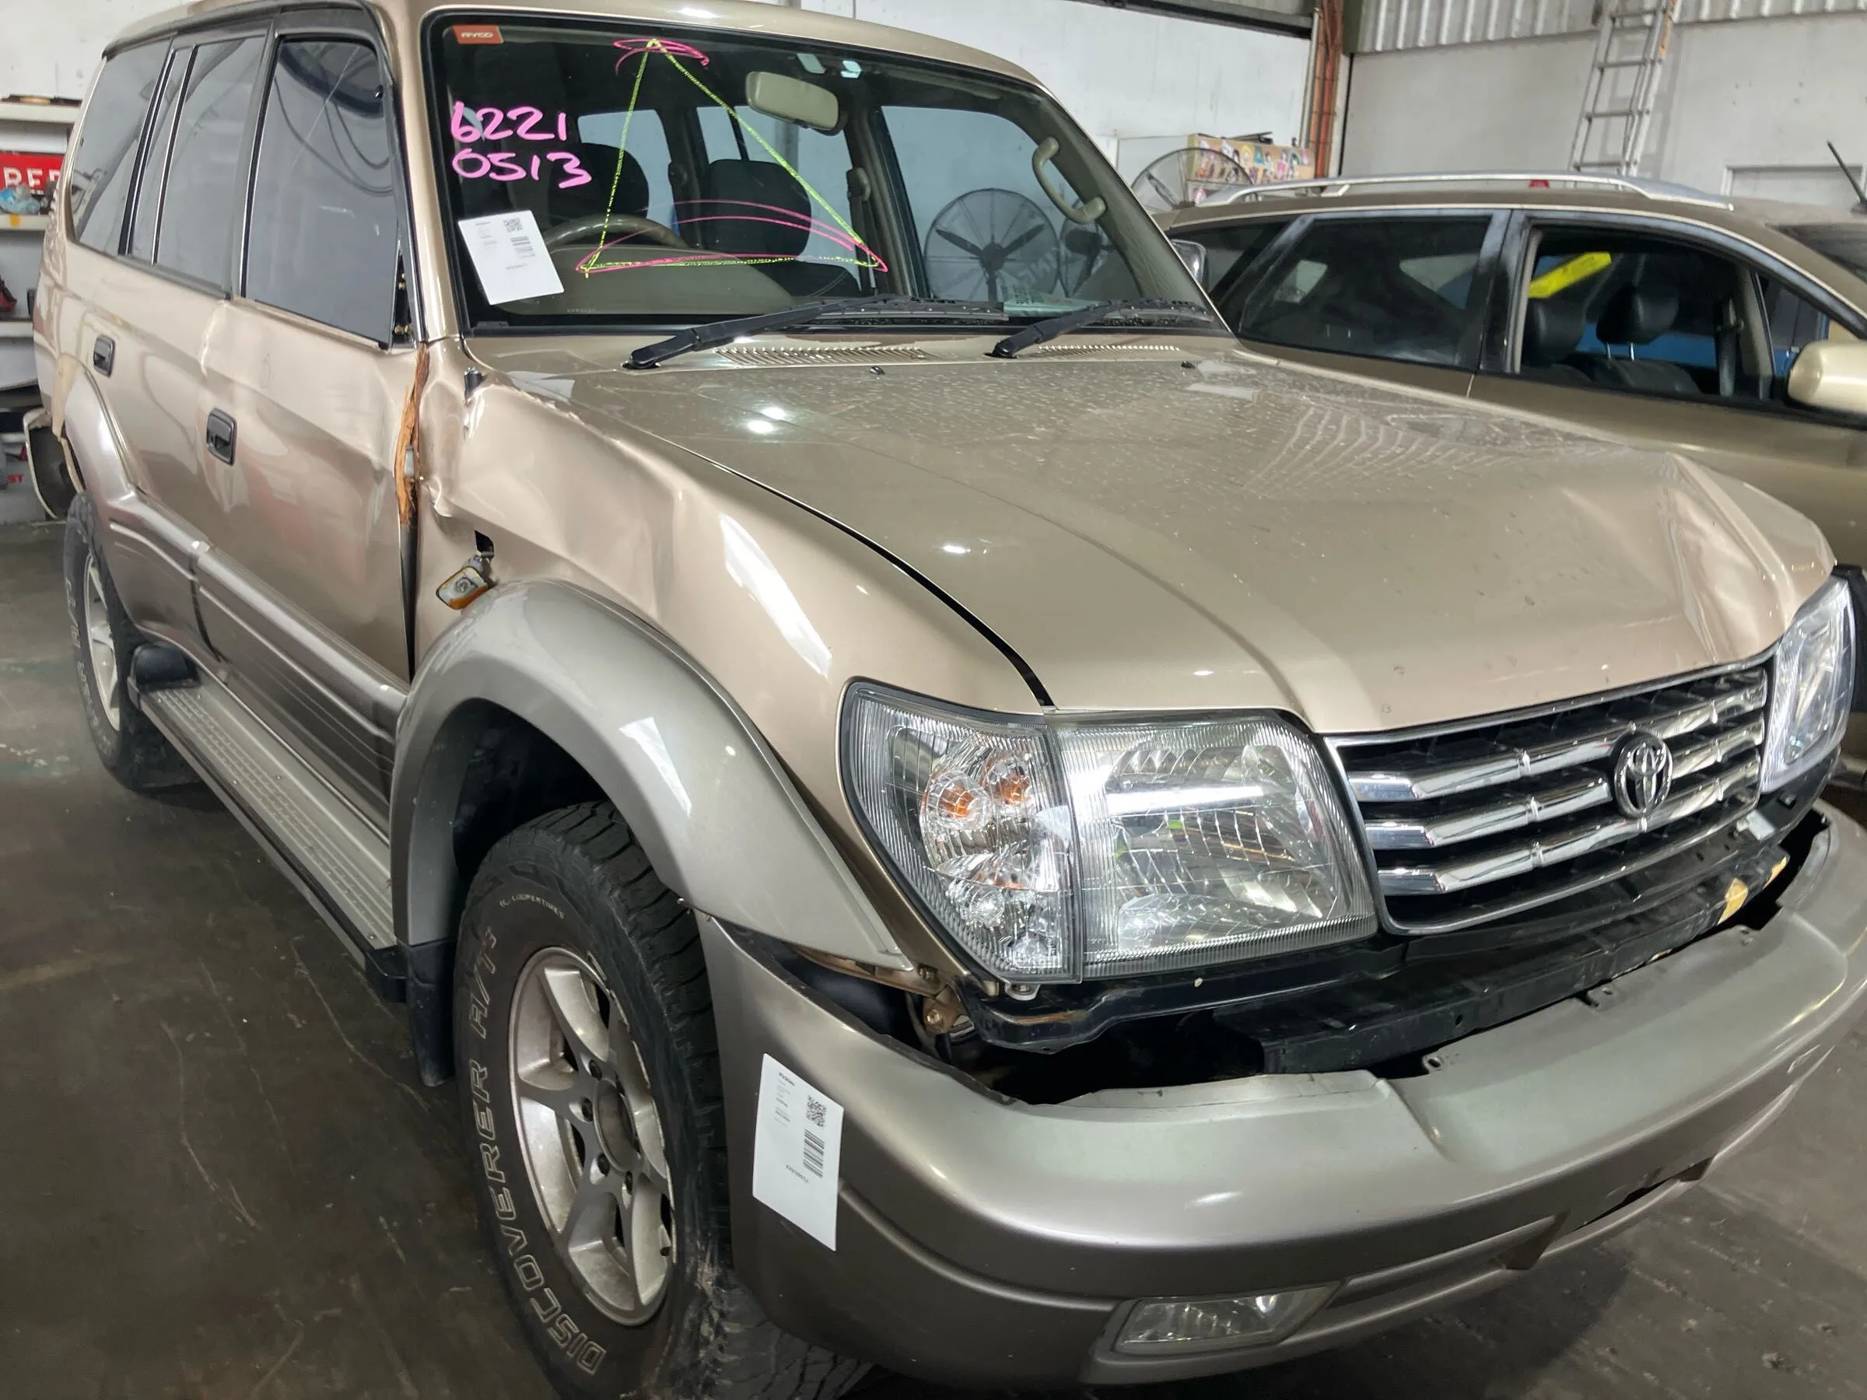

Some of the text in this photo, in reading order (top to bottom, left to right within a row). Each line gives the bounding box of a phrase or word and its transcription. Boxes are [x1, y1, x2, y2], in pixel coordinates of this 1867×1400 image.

[450, 100, 567, 143] 6221
[451, 148, 593, 189] 0513
[470, 1058, 607, 1376] DISCOVERER
